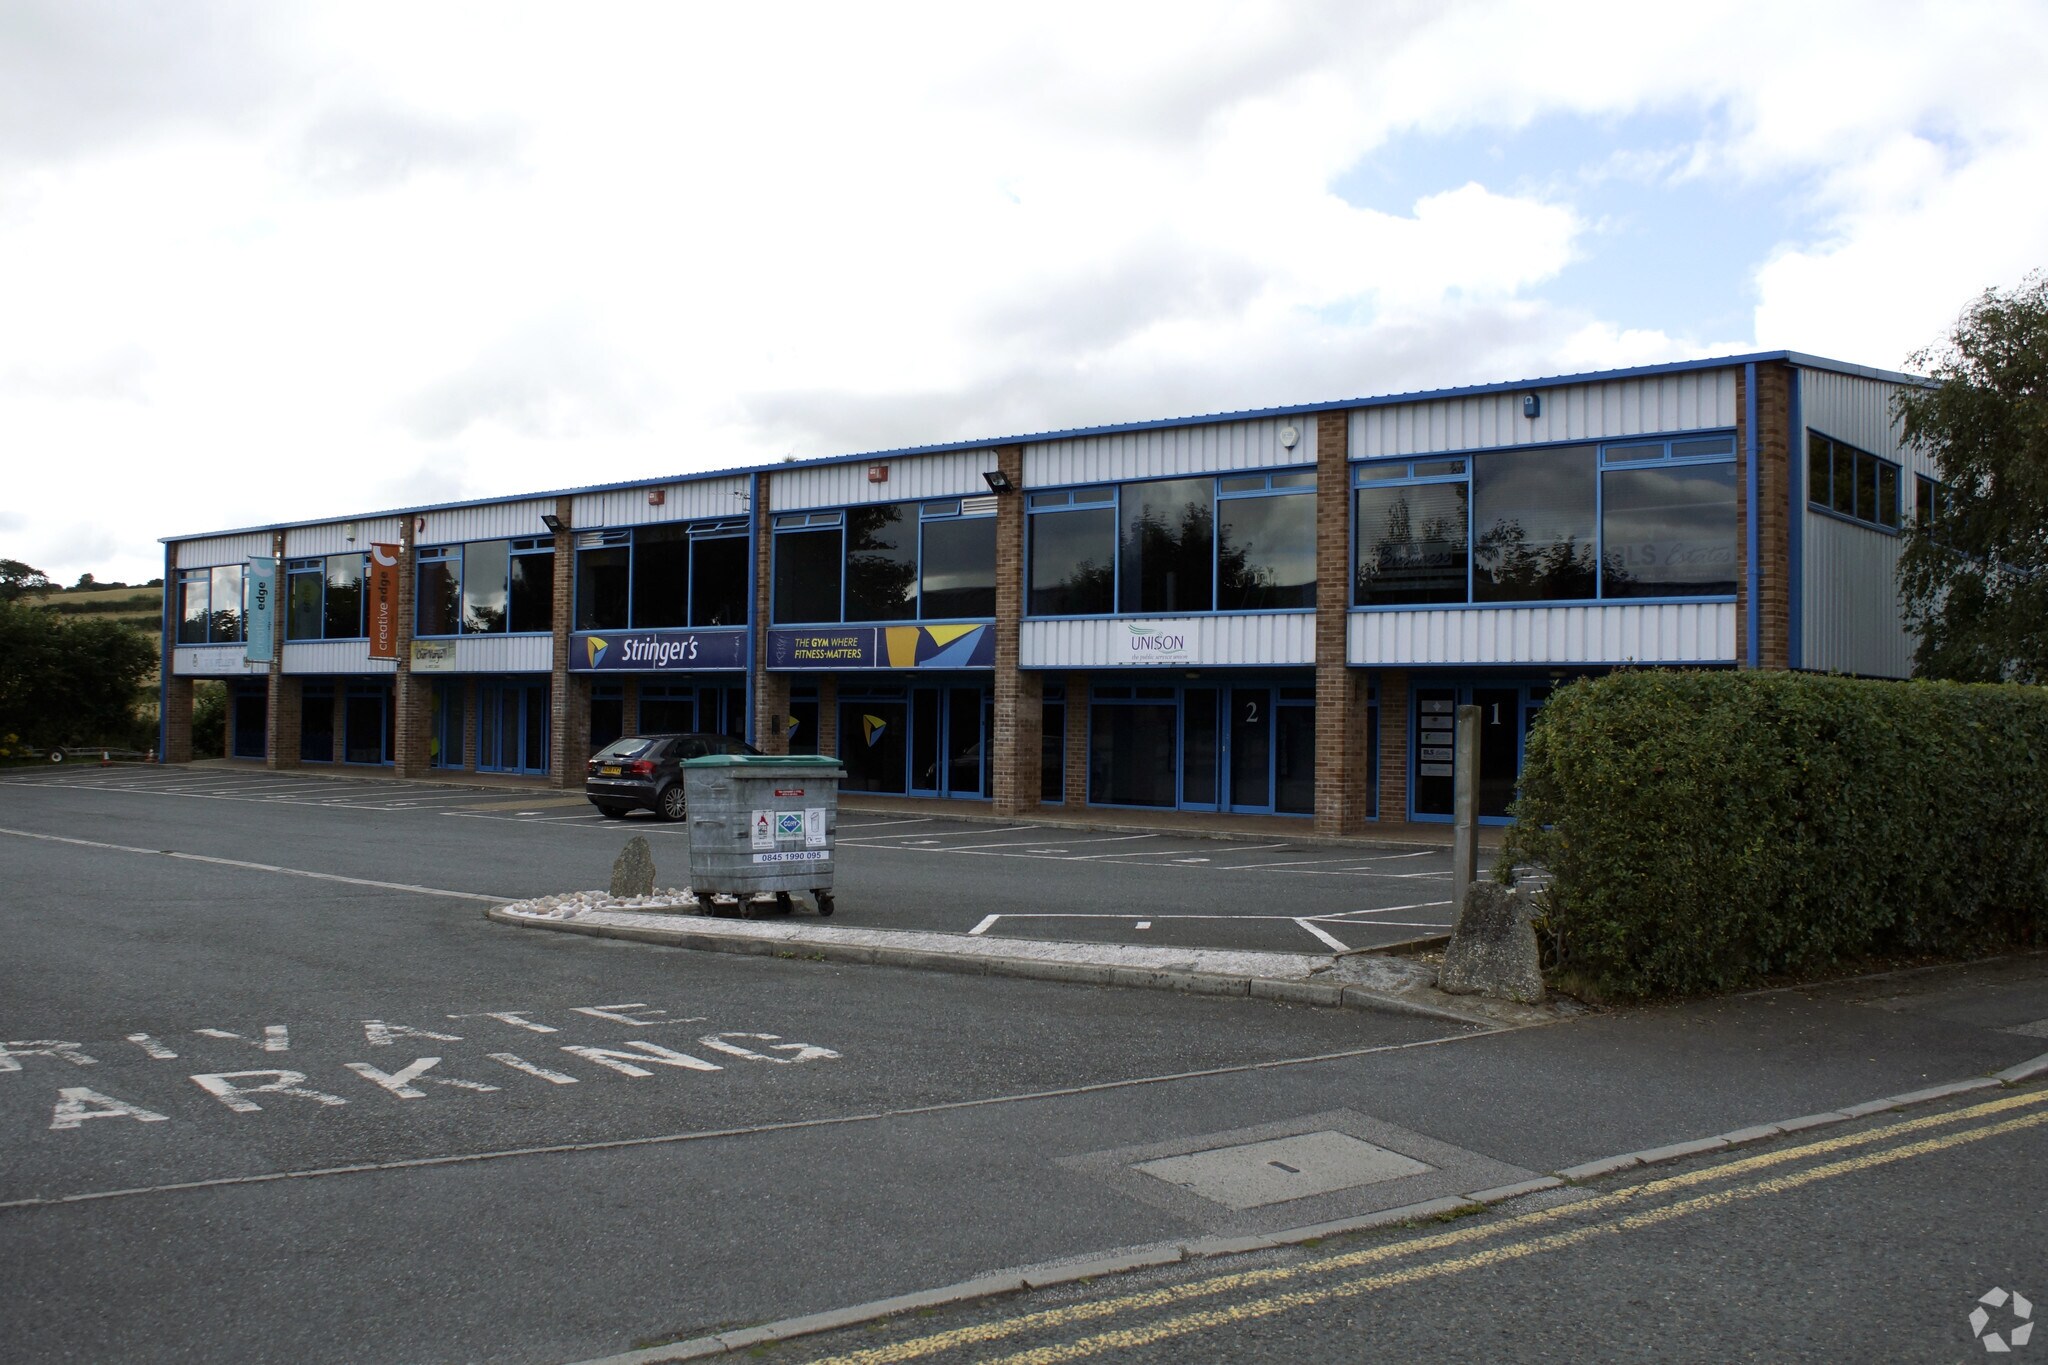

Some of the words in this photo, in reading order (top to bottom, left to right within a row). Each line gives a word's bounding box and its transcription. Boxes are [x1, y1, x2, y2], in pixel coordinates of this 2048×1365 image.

[256, 581, 269, 611] edge
[378, 570, 391, 602] edge
[377, 602, 389, 652] creative
[621, 635, 699, 667] Stringer's
[795, 638, 810, 648] THE
[811, 638, 829, 648] GYM
[830, 637, 859, 647] WHERE
[1131, 635, 1184, 651] UNISON
[1245, 701, 1258, 723] 2
[1490, 702, 1501, 725] 1
[762, 854, 782, 862] 0845
[785, 853, 804, 861] 1990
[806, 851, 821, 860] 095
